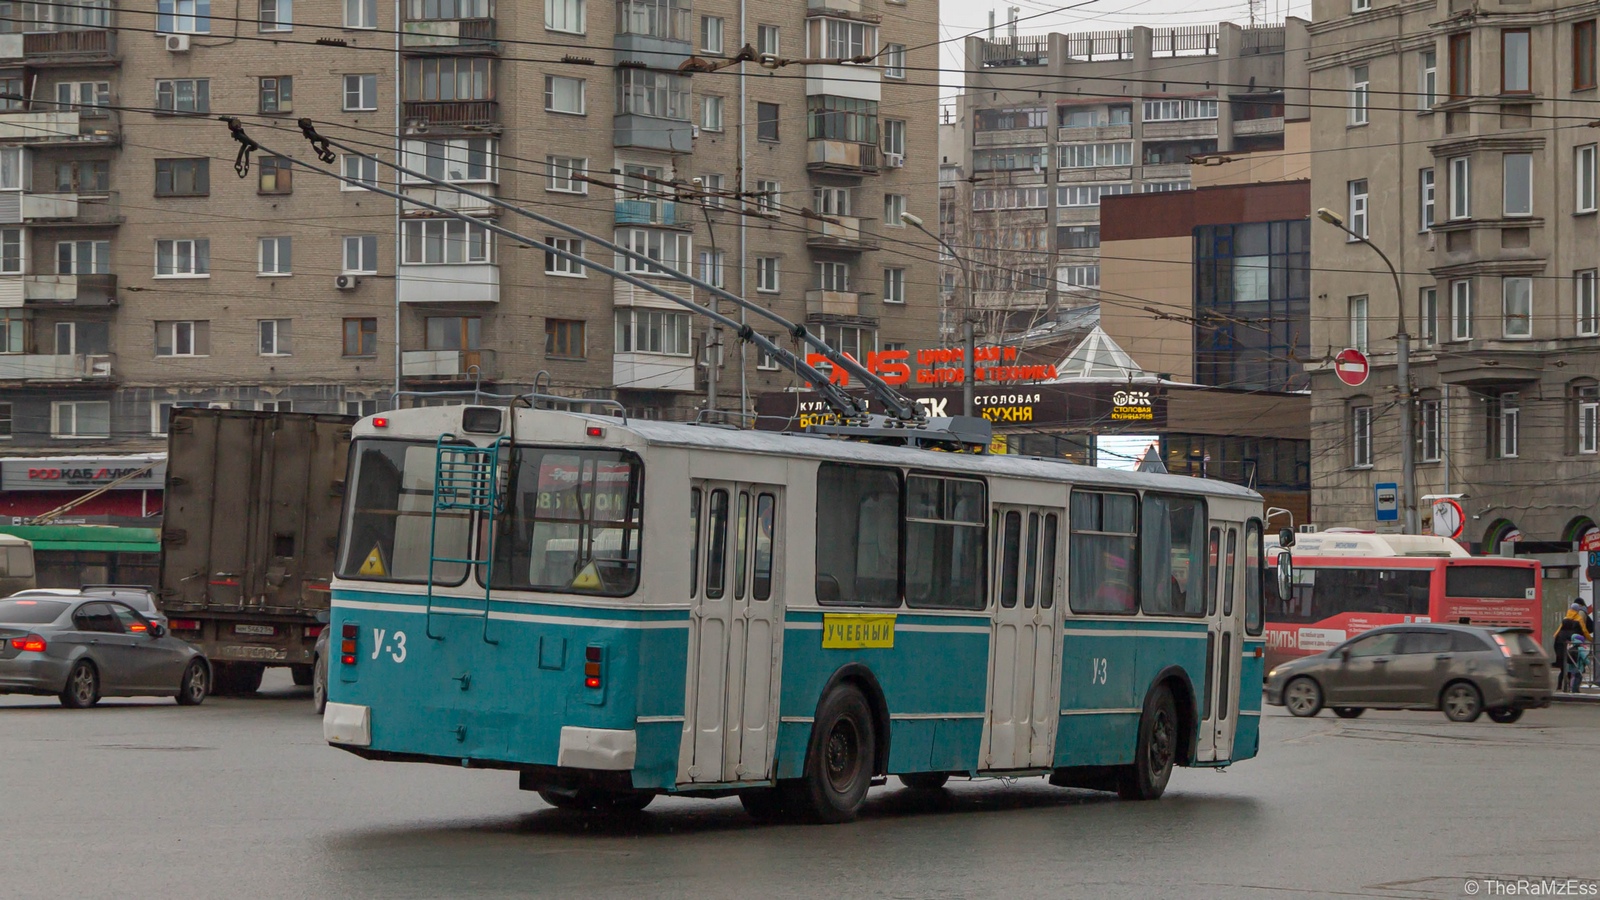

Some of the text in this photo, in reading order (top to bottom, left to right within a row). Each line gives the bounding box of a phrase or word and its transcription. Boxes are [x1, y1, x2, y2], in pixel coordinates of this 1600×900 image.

[917, 346, 1016, 366] ЦИФРВАЯ И
[917, 364, 1058, 383] БЫТОВЯ ТЕХНИКА
[974, 394, 1041, 405] СТОЛОВАЯ
[981, 406, 1033, 422] КУХНЯ
[828, 622, 889, 641] УЧЕБНЫЙ
